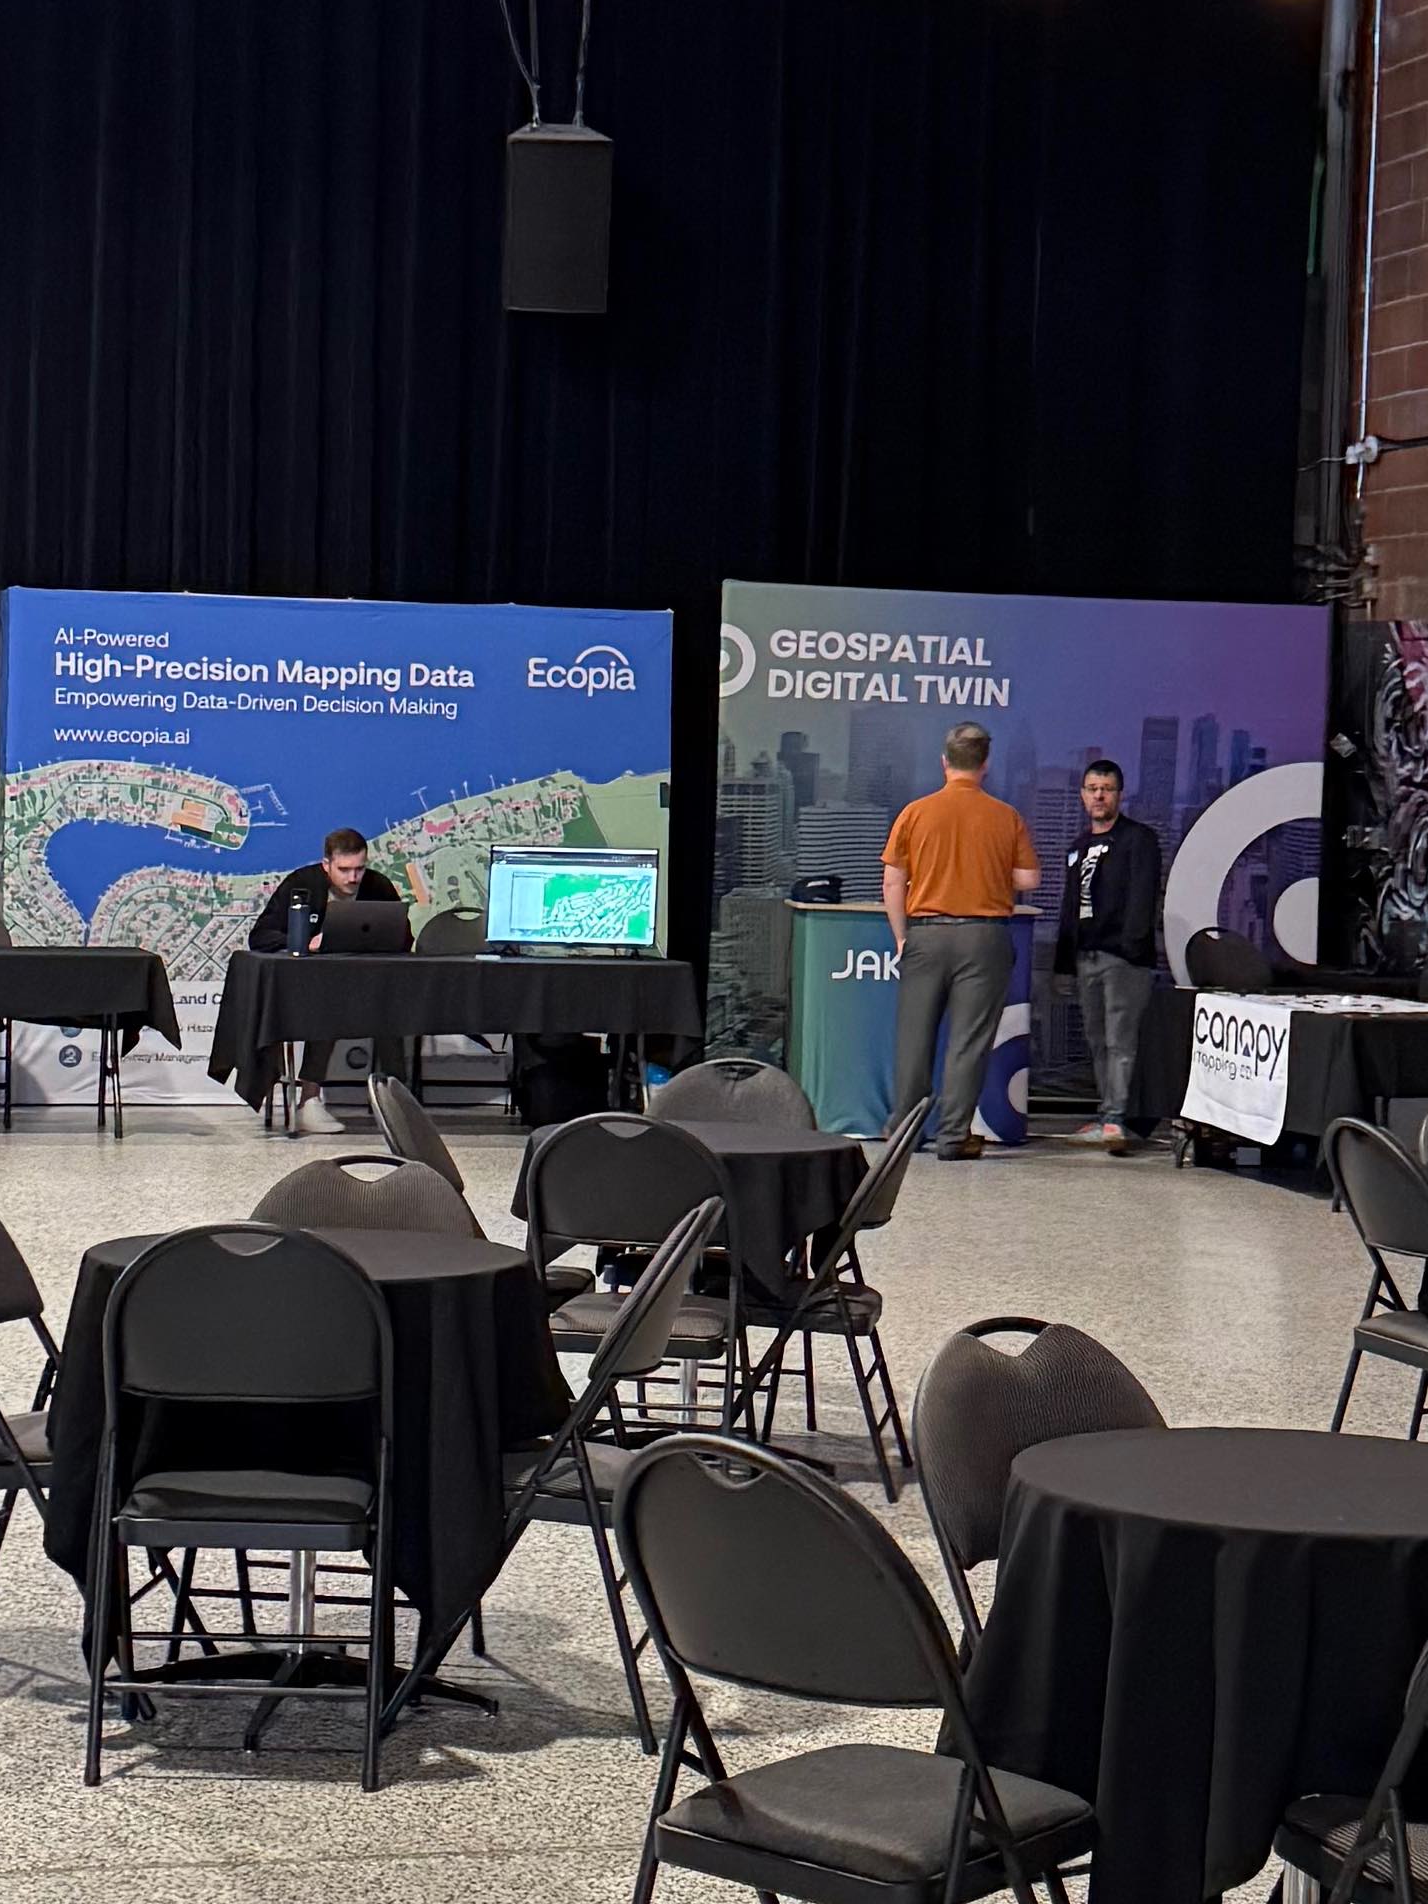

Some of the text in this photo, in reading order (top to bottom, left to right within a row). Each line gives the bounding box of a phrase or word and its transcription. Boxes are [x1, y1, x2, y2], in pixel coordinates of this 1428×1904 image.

[54, 627, 169, 648] AI-Powered
[769, 629, 992, 666] GEOSPATIAL
[54, 651, 475, 691] High-Precision Mapping Data
[527, 655, 636, 697] Ecopia
[767, 668, 1010, 707] DIGITAL TWIN
[54, 687, 458, 720] Empowering Data-Driven Decision Making
[54, 727, 190, 747] www.ecopia.ai
[831, 949, 902, 981] JAK
[1195, 1007, 1287, 1081] canopy
